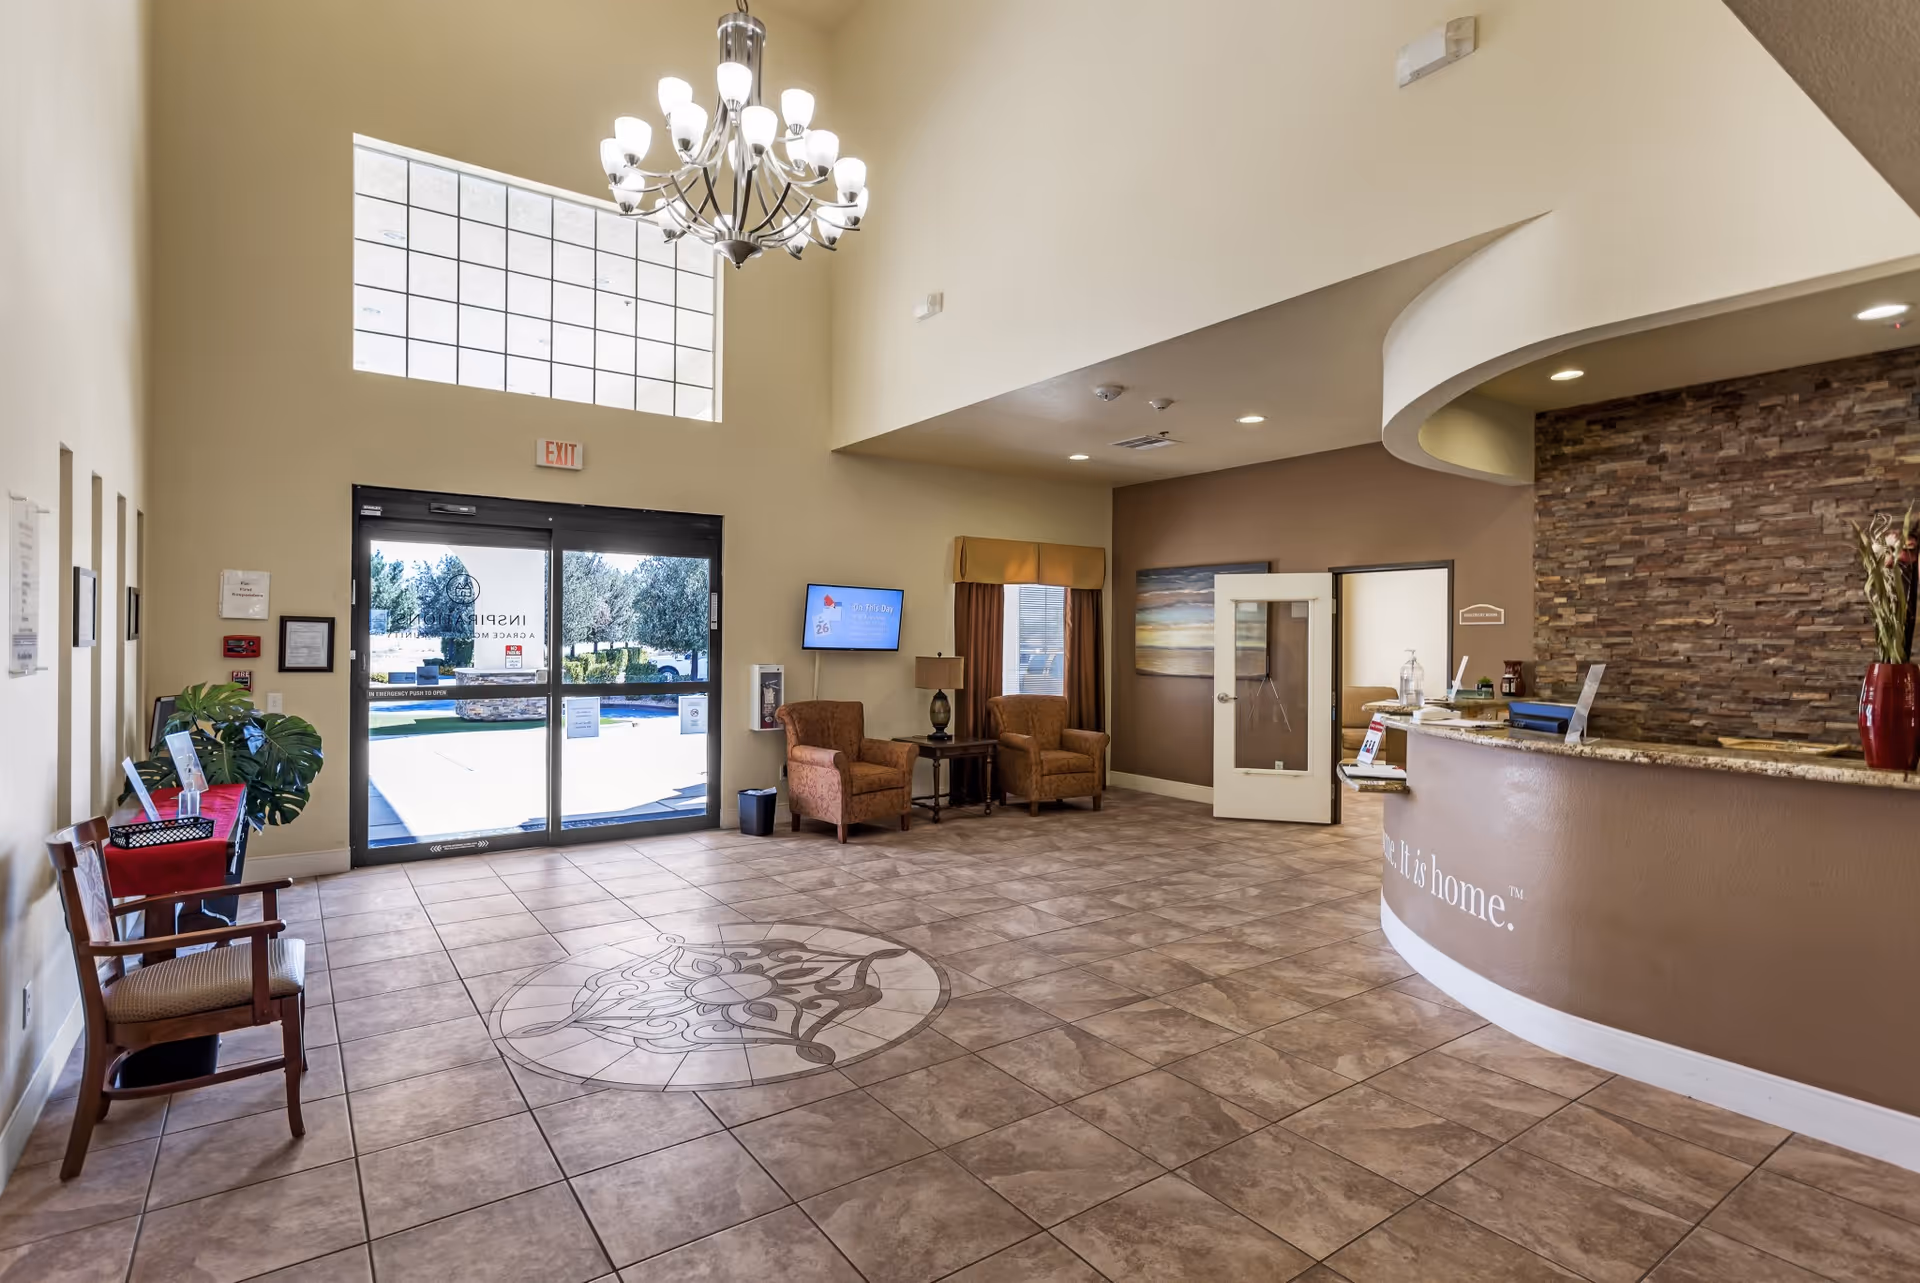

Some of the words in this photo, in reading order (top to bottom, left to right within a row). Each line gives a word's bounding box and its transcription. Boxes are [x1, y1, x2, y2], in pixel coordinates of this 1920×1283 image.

[545, 441, 577, 466] EXIT
[865, 603, 879, 612] This
[881, 604, 895, 614] Day
[816, 623, 829, 635] 26
[1400, 839, 1411, 879] It
[1413, 849, 1427, 888] is
[1431, 854, 1515, 932] home.
